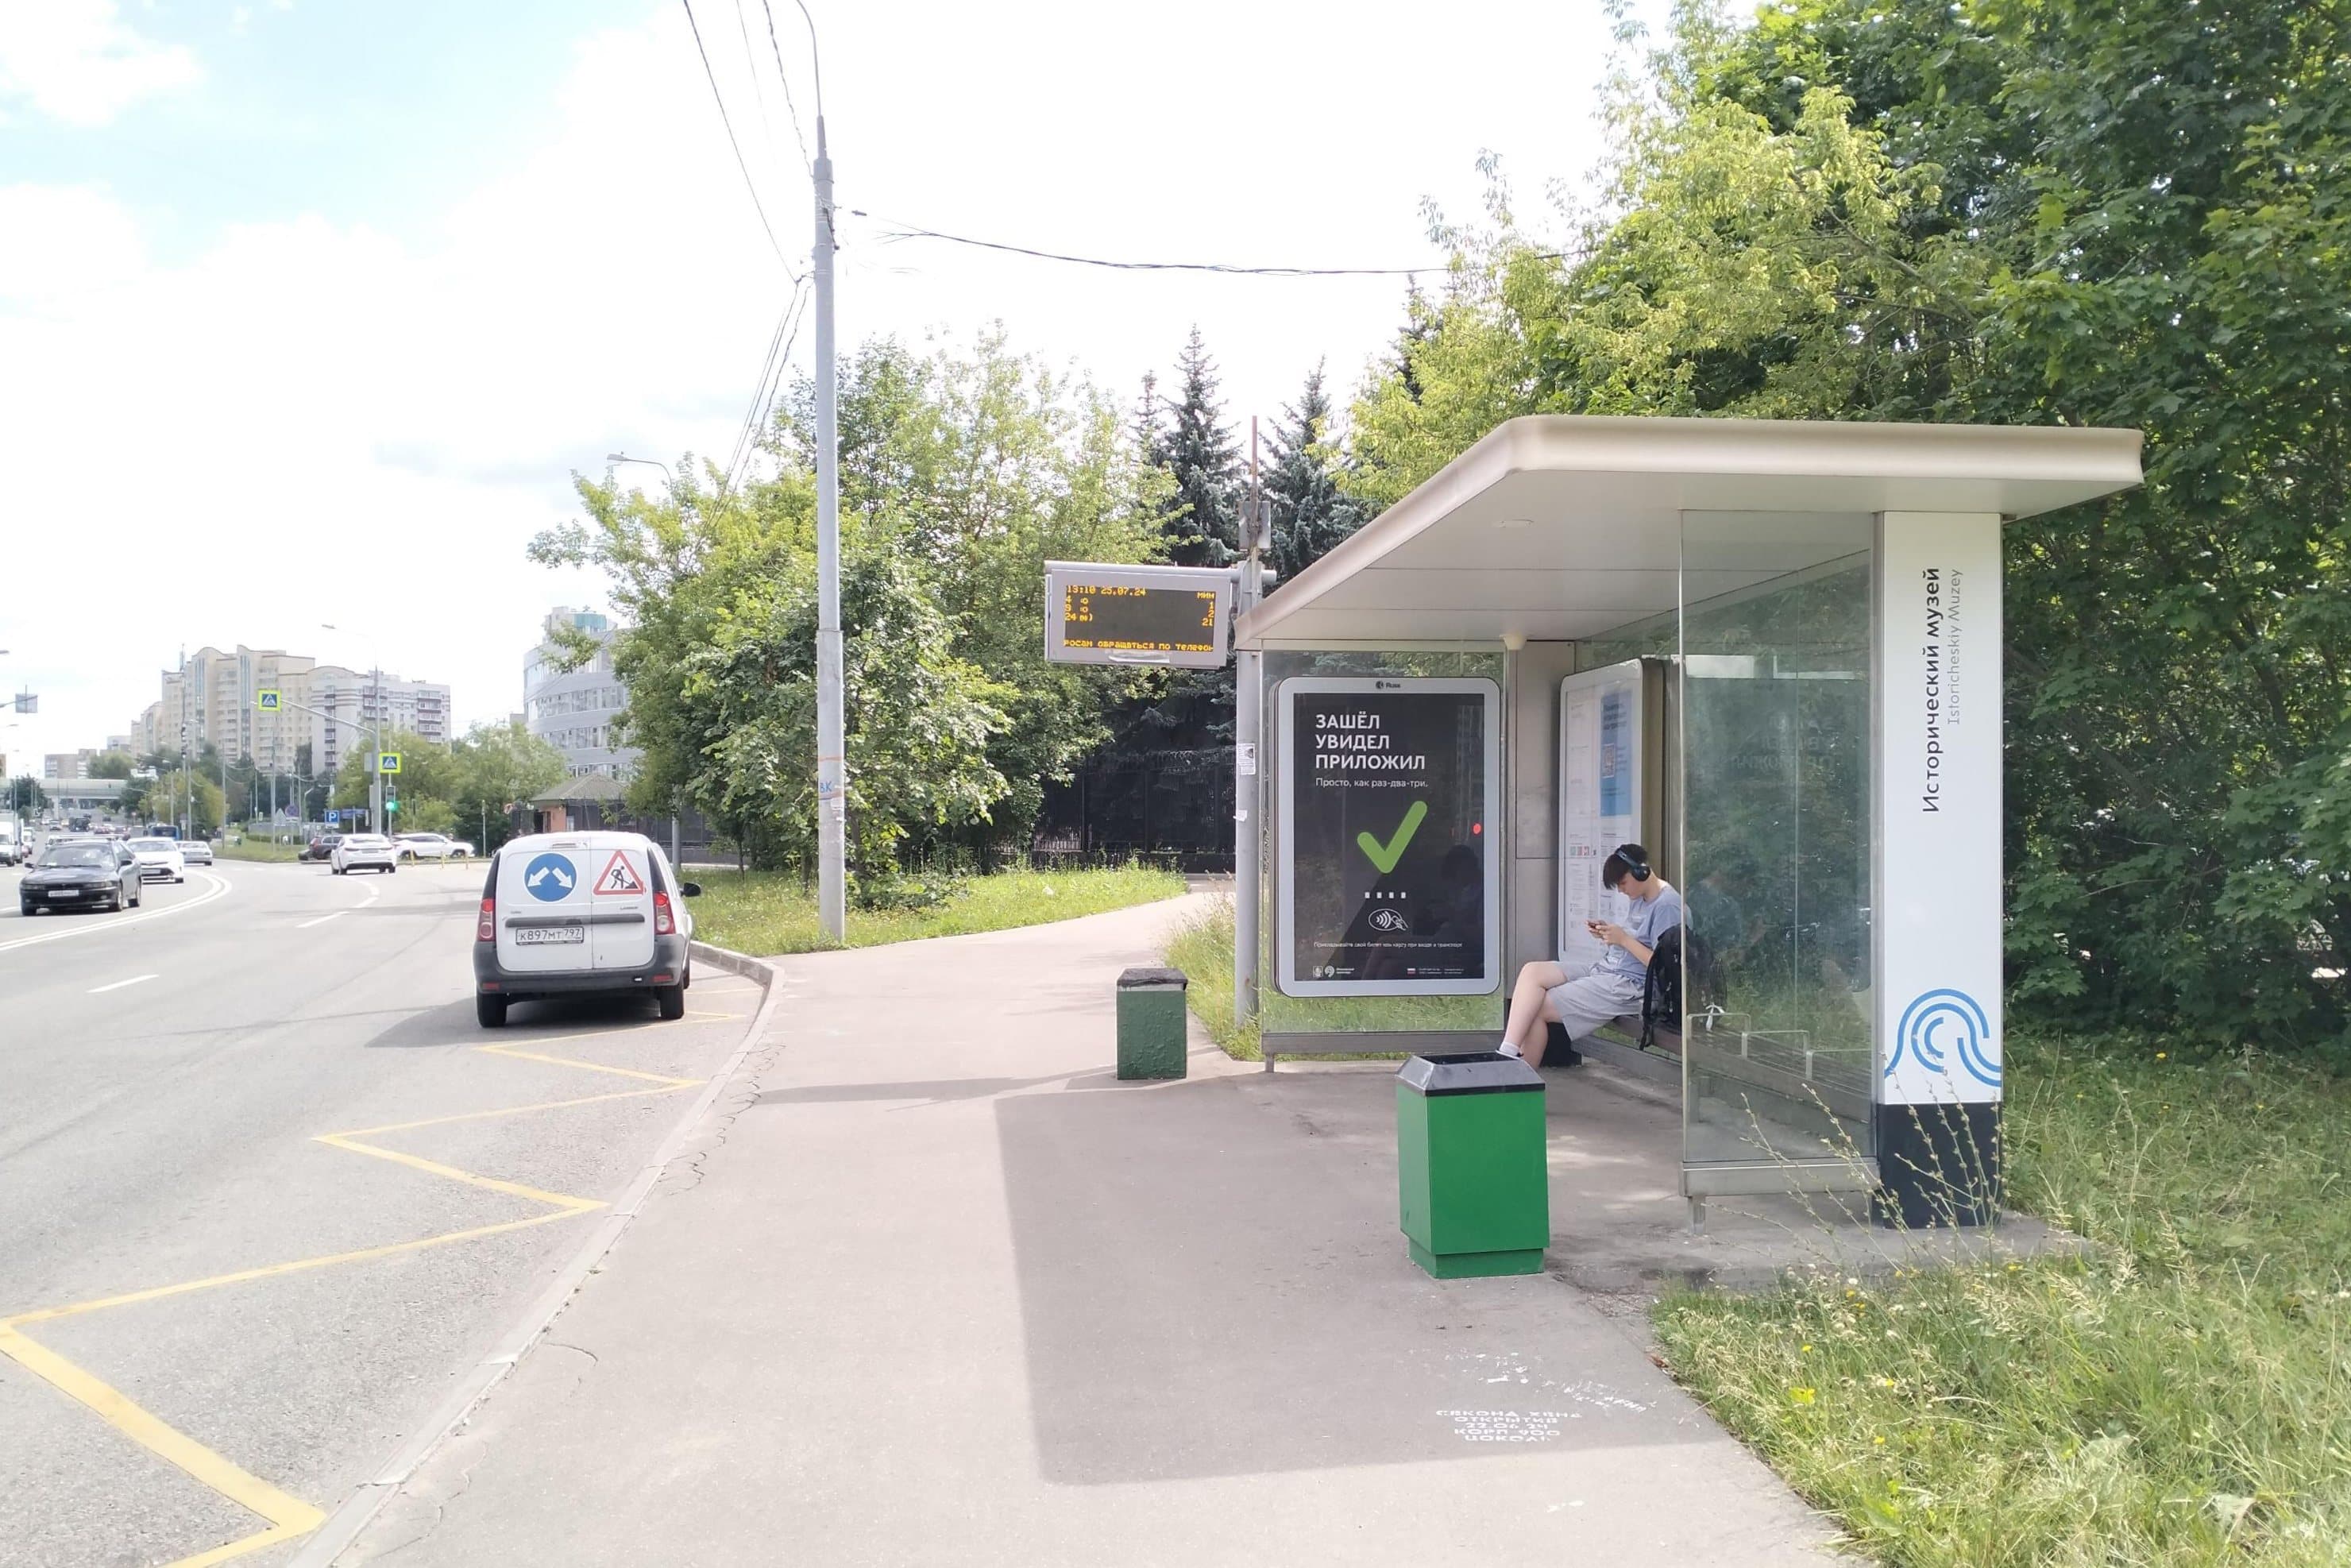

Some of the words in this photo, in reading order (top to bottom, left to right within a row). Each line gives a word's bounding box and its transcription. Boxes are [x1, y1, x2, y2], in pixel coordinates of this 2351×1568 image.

[1100, 586, 1146, 597] 25.07.24
[1948, 568, 1964, 622] Muzey
[1065, 595, 1072, 604] 4
[1209, 601, 1214, 609] 1
[1923, 567, 1944, 638] музей
[1064, 612, 1077, 621] 24
[1202, 617, 1214, 627] 21
[1948, 624, 1963, 725] Istoricheskiy
[1315, 711, 1380, 730] ЗАШЁЛ
[1922, 647, 1944, 812] Исторический
[1315, 735, 1390, 751] УВИДЕЛ
[1315, 755, 1426, 770] ПРИЛОЖИЛ
[1315, 777, 1352, 788] Просто,
[1353, 778, 1369, 787] как
